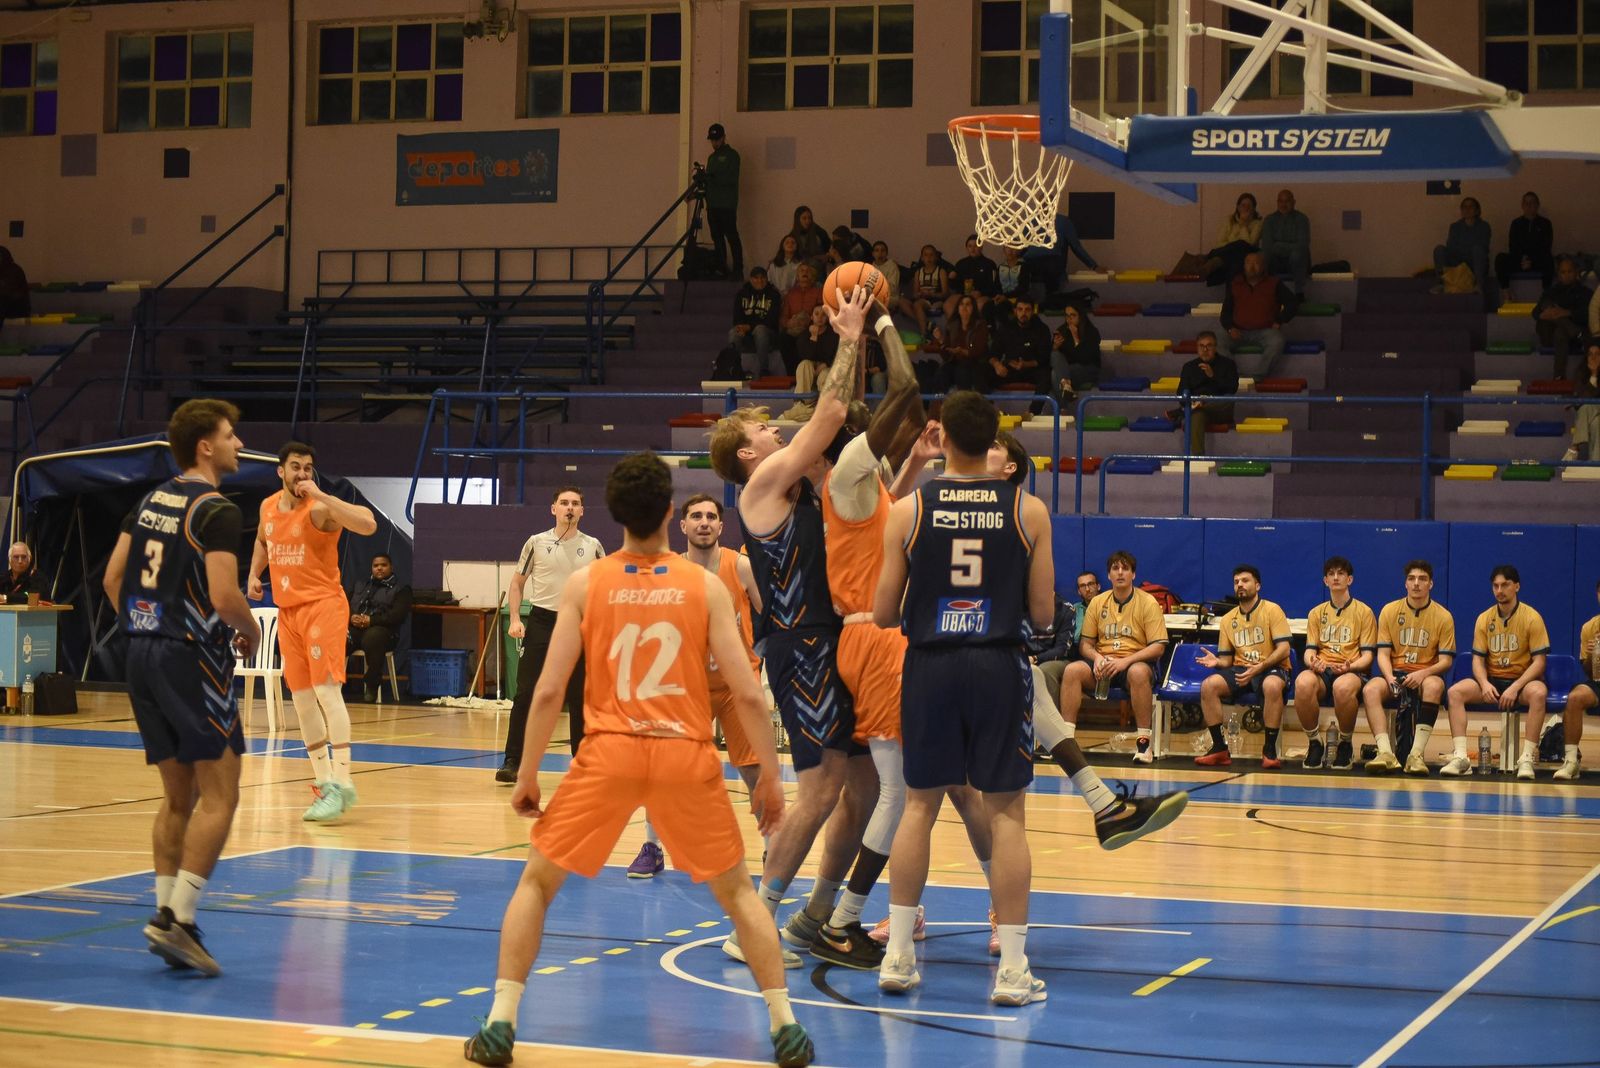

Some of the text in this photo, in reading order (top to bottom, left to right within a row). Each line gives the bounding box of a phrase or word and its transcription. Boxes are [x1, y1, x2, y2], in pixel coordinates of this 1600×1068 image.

[408, 155, 521, 184] deportes
[939, 489, 998, 503] CABRERA
[960, 511, 1004, 529] STROG
[140, 539, 164, 589] 3
[951, 539, 983, 587] 5
[281, 575, 290, 592] 9
[607, 587, 688, 605] LIBERATORE
[942, 611, 985, 632] UBAGO
[1234, 626, 1264, 648] ULB
[1319, 625, 1351, 643] ULB
[1400, 628, 1429, 648] ULB
[1490, 633, 1519, 653] ULB
[607, 621, 687, 702] 12
